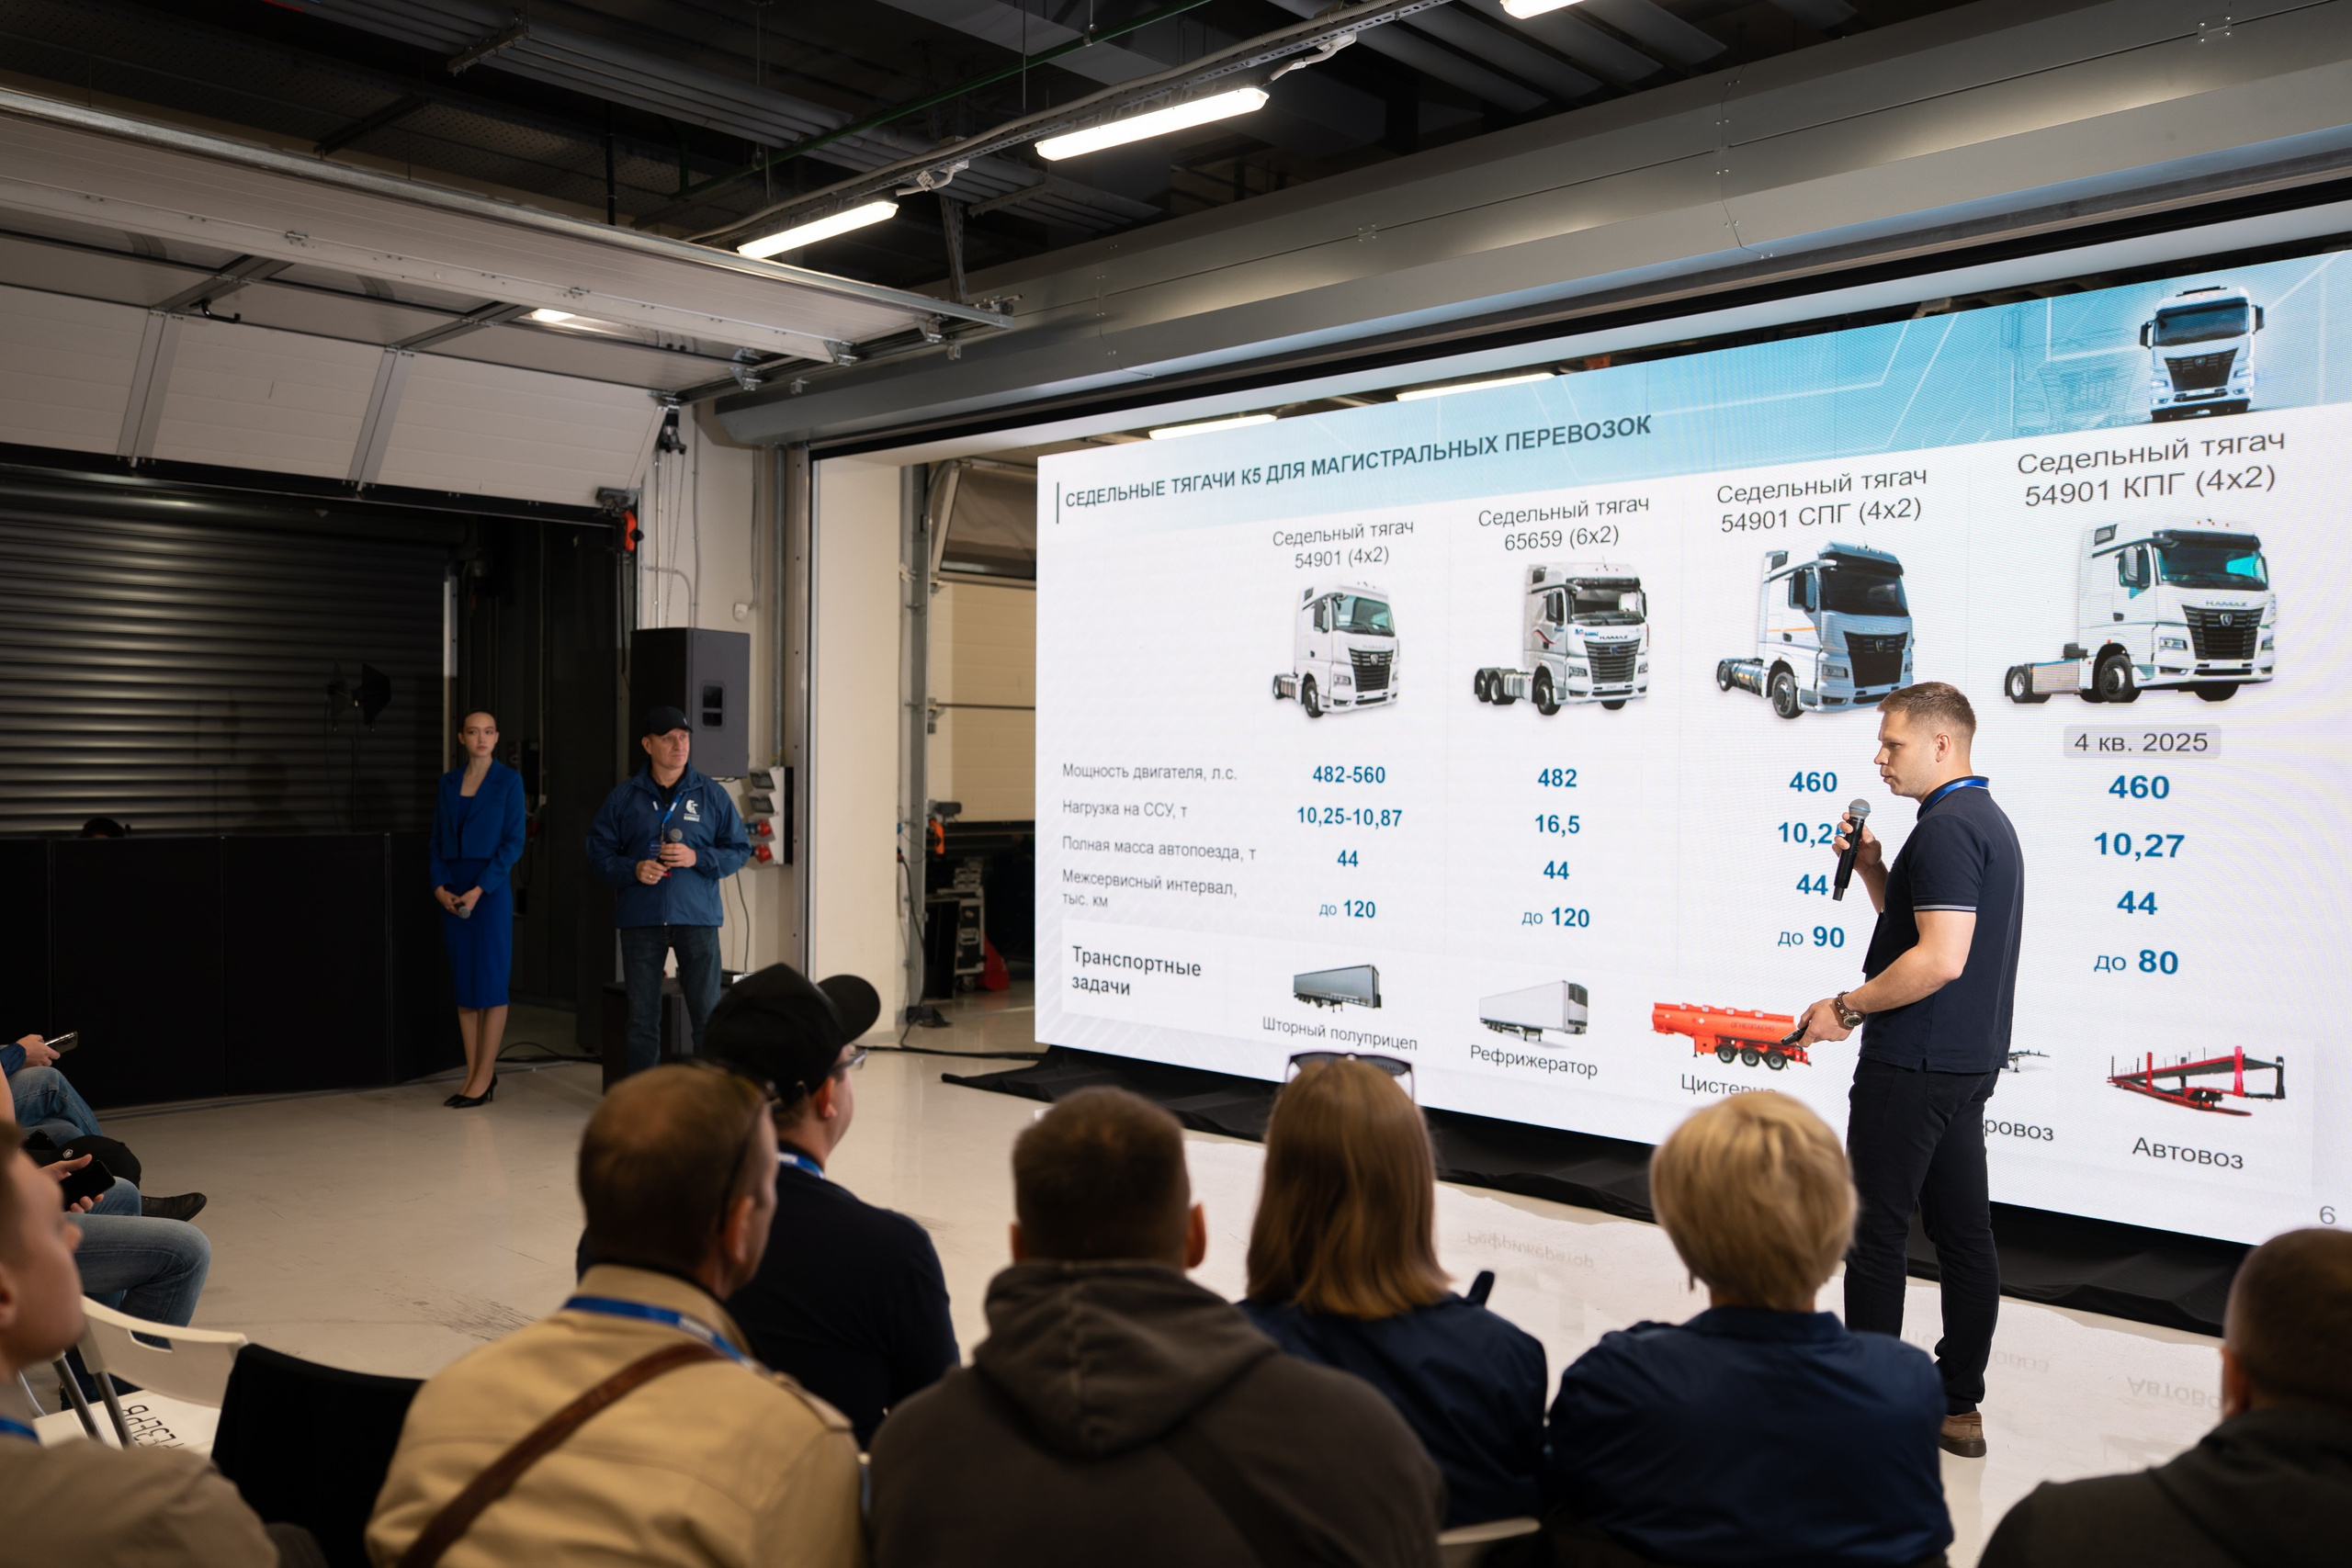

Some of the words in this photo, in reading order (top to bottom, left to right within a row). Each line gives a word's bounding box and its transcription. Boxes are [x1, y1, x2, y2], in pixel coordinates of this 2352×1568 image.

[1065, 479, 1166, 508] СЕДЕЛЬНЫЕ
[1170, 470, 1235, 494] ТЯГАЧИ
[1241, 467, 1261, 485] К5
[1265, 461, 1306, 485] ДЛЯ
[1311, 434, 1498, 477] МАГИСТРАЛЬНЫХ
[1505, 413, 1652, 452] ПЕРЕВОЗОК
[2018, 437, 2188, 476] Седельный
[2200, 433, 2285, 457] тягач
[1716, 472, 1852, 505] Седельный
[1860, 469, 1927, 490] тягач
[2025, 479, 2108, 507] 54901
[2124, 472, 2186, 499] КПГ
[1478, 500, 1589, 528] Седельный
[1596, 498, 1649, 515] тягач
[1721, 509, 1787, 533] 54901
[1798, 502, 1851, 526] СПГ
[1272, 523, 1364, 547] Седельный
[1370, 522, 1414, 537] тягач
[1504, 529, 1563, 551] 65659
[1295, 550, 1340, 570] 54901
[2074, 733, 2089, 751] 4
[2098, 737, 2132, 752] кв.
[2143, 732, 2209, 752] 2025
[1062, 762, 1130, 779] Мощность
[1132, 766, 1207, 784] двигателя,
[1211, 768, 1238, 782] л.с.
[1312, 765, 1385, 784] 482-560
[1537, 768, 1577, 788] 482
[1789, 771, 1838, 793] 460
[2108, 774, 2170, 799] 460
[1062, 799, 1120, 818] Нагрузка
[1124, 805, 1140, 817] на
[1143, 801, 1176, 819] ССУ,
[1180, 806, 1188, 818] т
[1297, 807, 1403, 829] 10,25-10,87
[1535, 814, 1580, 838] 16,5
[1062, 835, 1110, 852] Полная
[1114, 841, 1154, 854] масса
[1158, 843, 1244, 862] автопоезда,
[1249, 848, 1257, 861] т
[2094, 831, 2186, 862] 10,27
[1337, 850, 1359, 867] 44
[1543, 860, 1570, 880] 44
[1062, 868, 1162, 892] Межсервисный
[1166, 878, 1238, 897] интервал,
[1795, 874, 1829, 896] 44
[1062, 893, 1089, 908] тыс.
[1092, 897, 1108, 908] км
[1318, 904, 1338, 918] до
[1343, 899, 1376, 919] 120
[2116, 889, 2158, 916] 44
[1521, 911, 1544, 926] до
[1551, 907, 1590, 928] 120
[1777, 931, 1804, 948] до
[1813, 925, 1845, 949] 90
[1072, 945, 1202, 977] Транспортные
[2093, 954, 2127, 974] до
[2138, 949, 2179, 976] 80
[1072, 976, 1130, 996] задачи
[1262, 1016, 1326, 1038] Шторный
[1330, 1028, 1418, 1051] полуприцеп
[1470, 1044, 1599, 1080] Рефрижератор
[1681, 1073, 1775, 1095] Цистер
[1984, 1119, 2054, 1142] ровоз
[2132, 1136, 2244, 1169] Автовоз
[2319, 1205, 2336, 1225] 6
